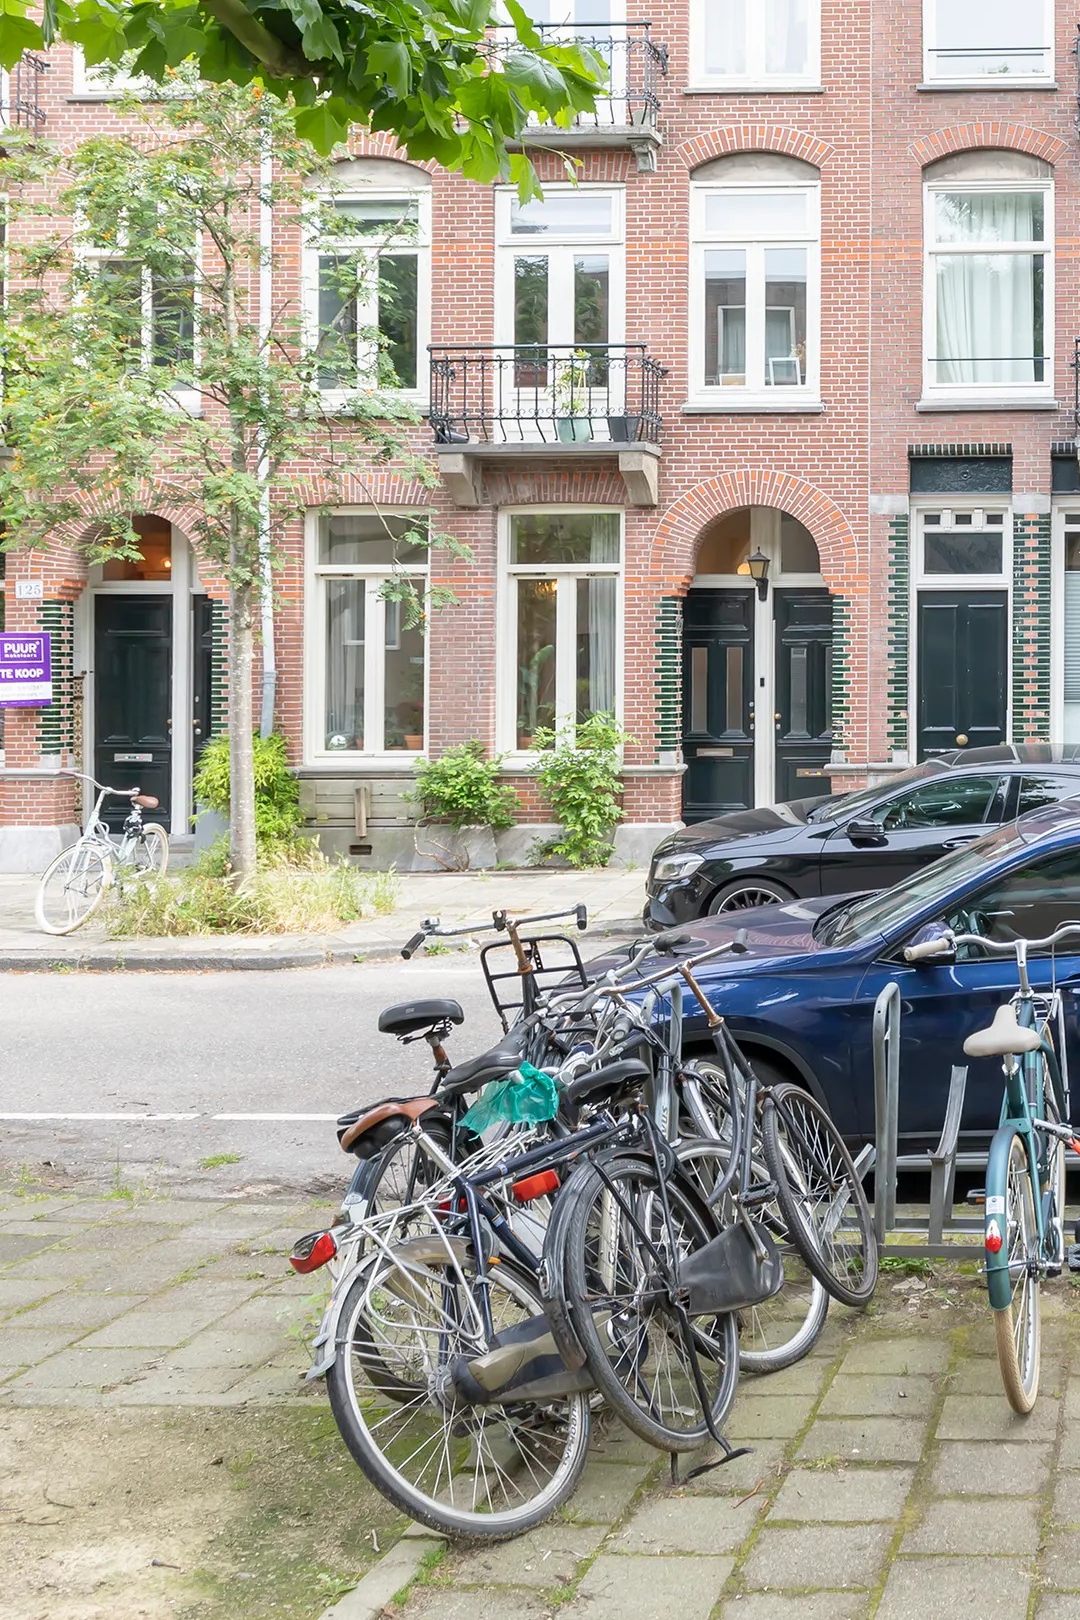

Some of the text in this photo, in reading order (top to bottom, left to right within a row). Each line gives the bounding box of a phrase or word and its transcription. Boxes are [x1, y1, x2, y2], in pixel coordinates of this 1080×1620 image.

[18, 584, 41, 595] 125
[4, 642, 37, 653] PUUR
[0, 668, 44, 678] TE KOOP
